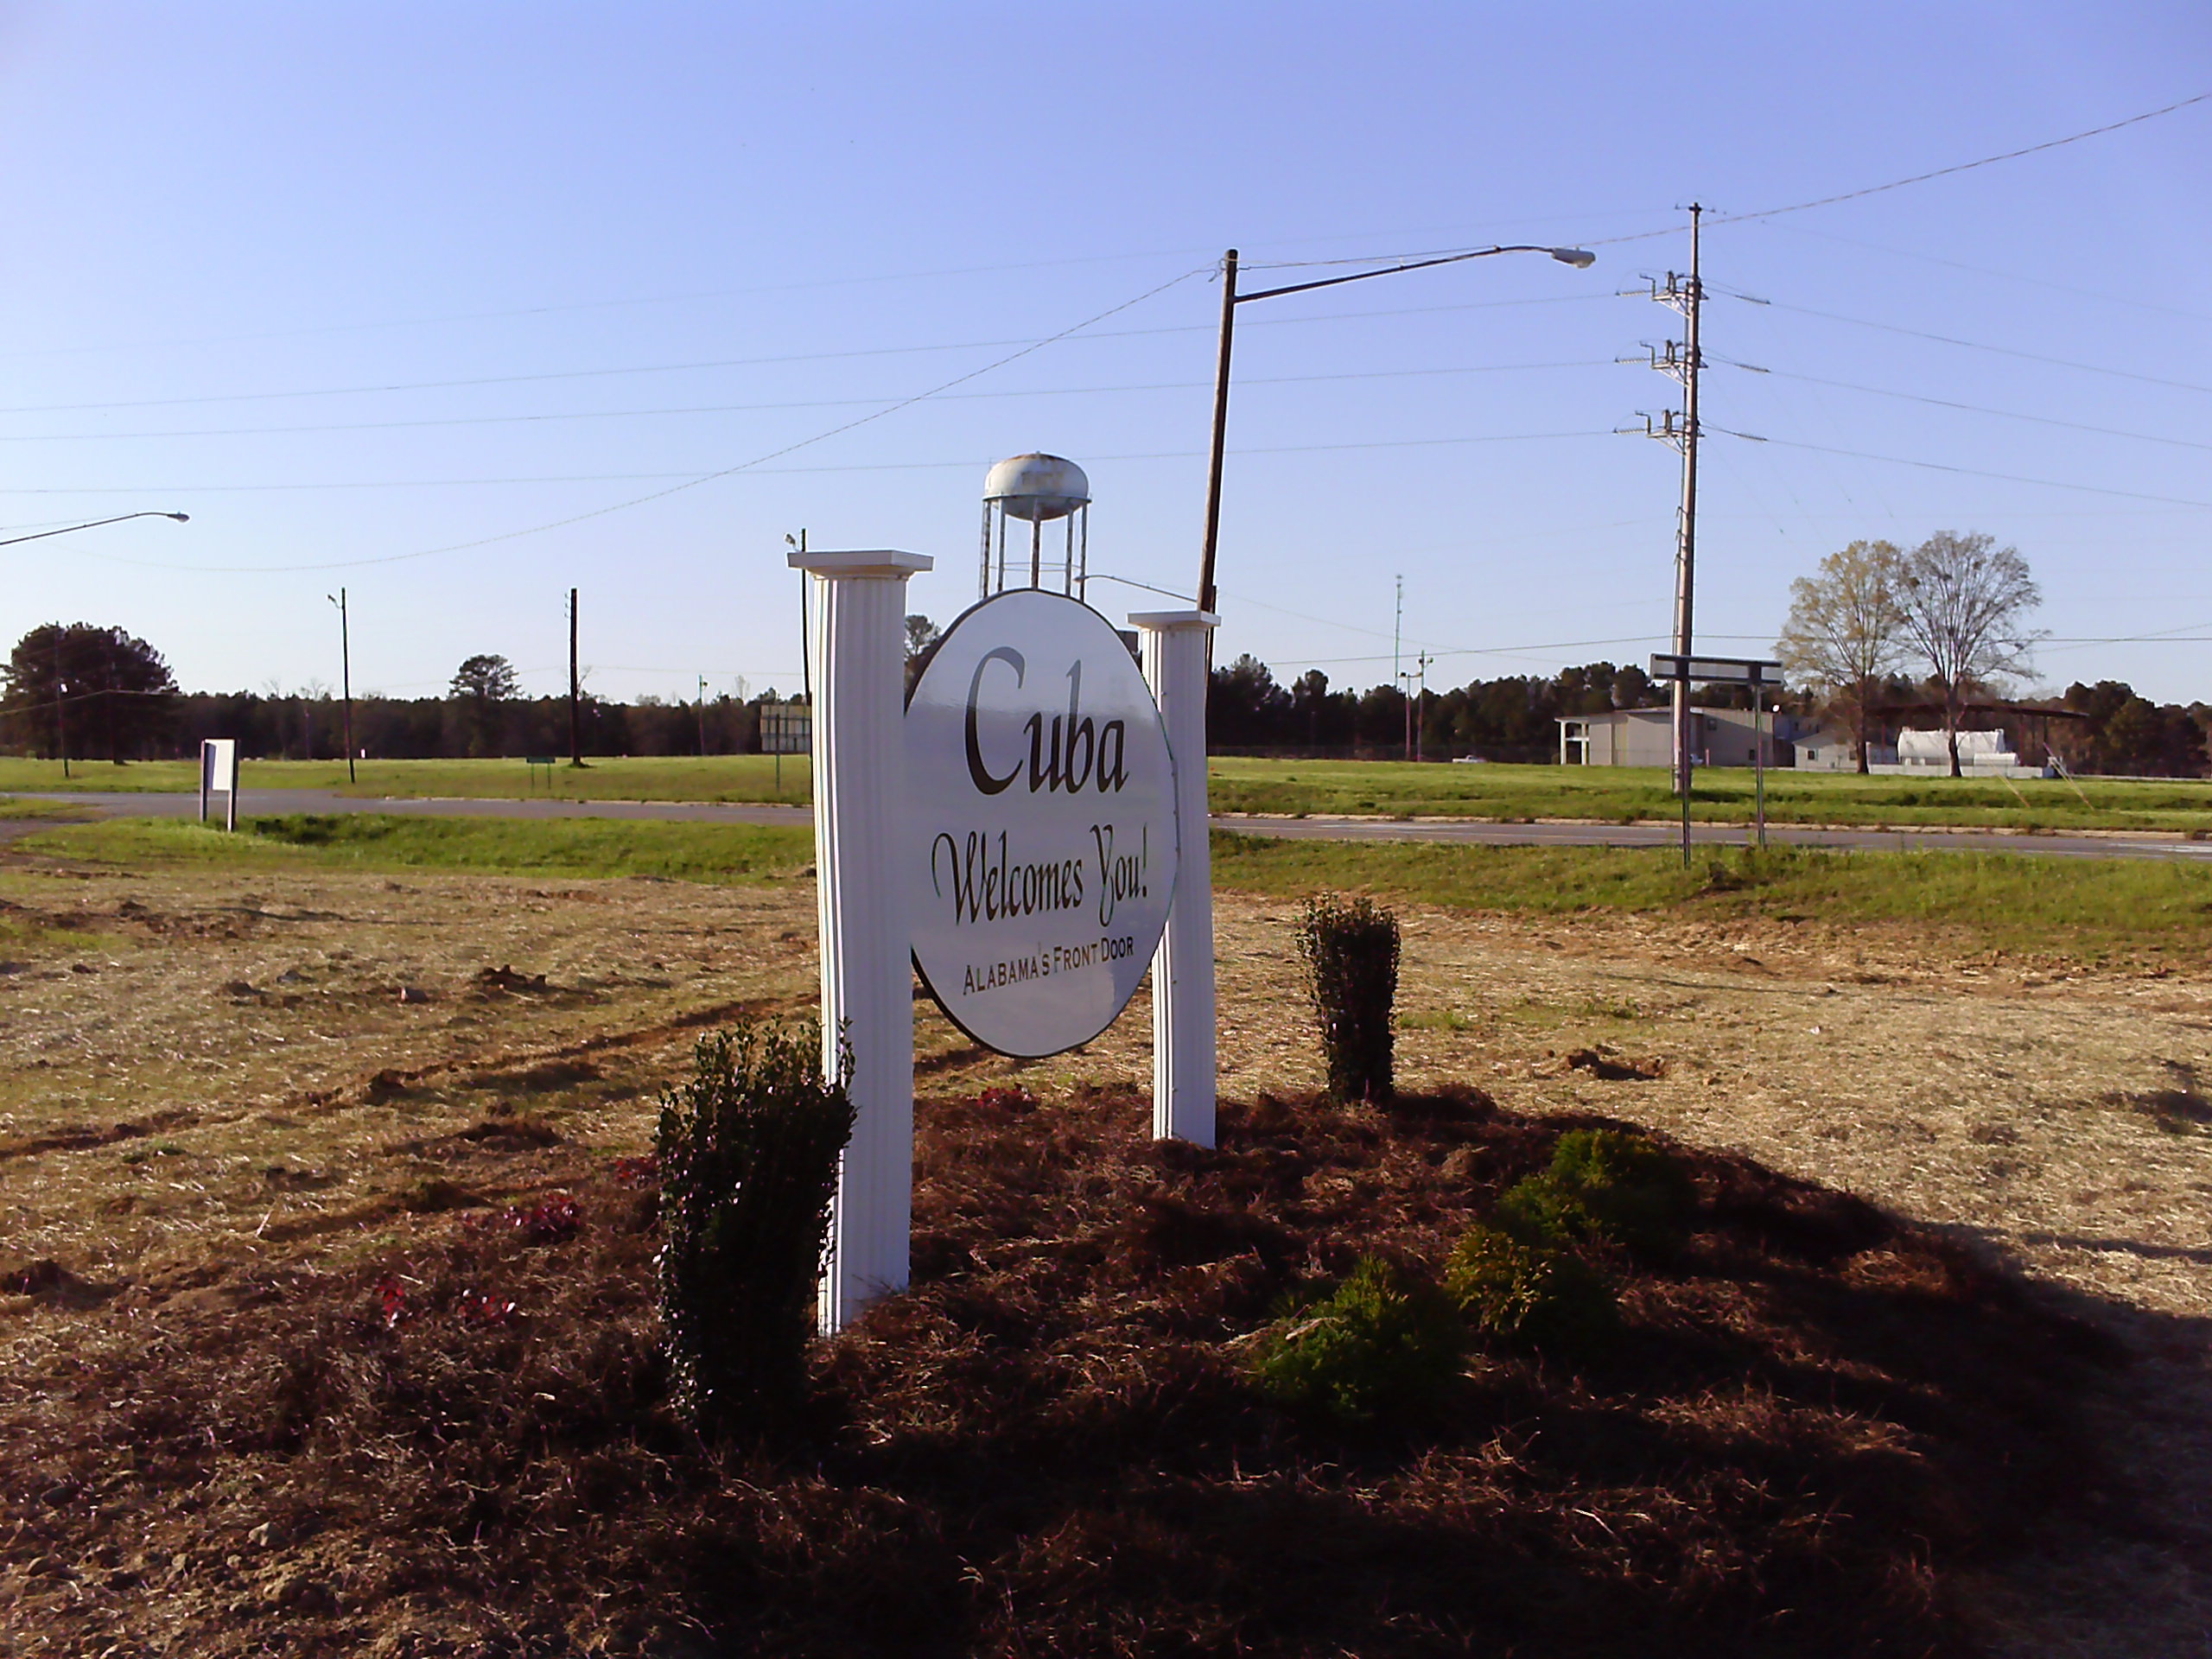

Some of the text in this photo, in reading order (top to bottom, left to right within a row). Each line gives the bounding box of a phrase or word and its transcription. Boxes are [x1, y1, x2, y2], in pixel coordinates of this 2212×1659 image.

[965, 646, 1128, 795] Cuba
[931, 823, 1147, 927] Welcomes You!
[1053, 944, 1097, 973] FRONT
[1101, 936, 1134, 963] DOOR
